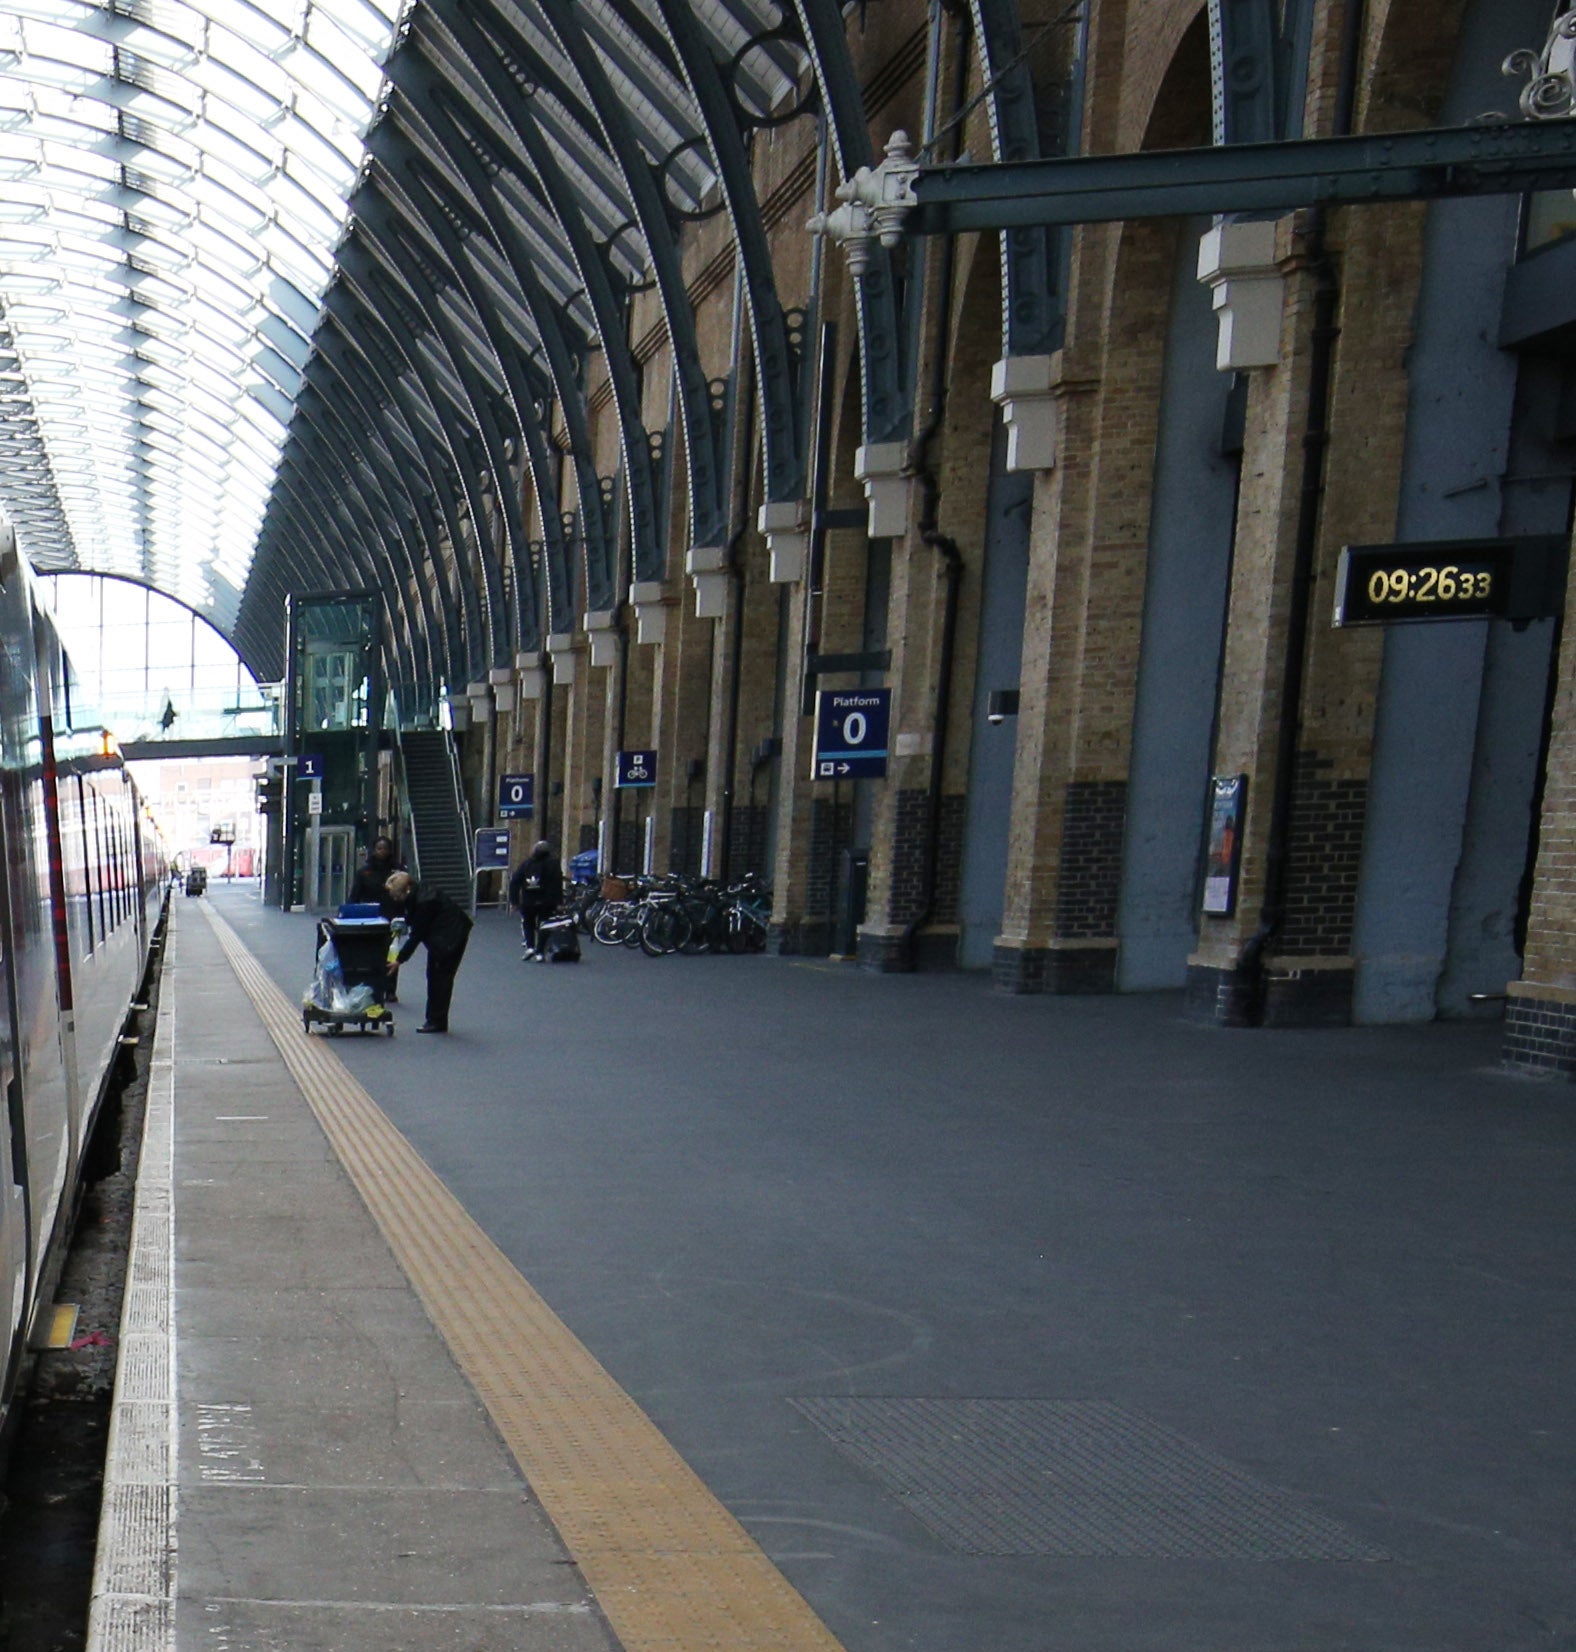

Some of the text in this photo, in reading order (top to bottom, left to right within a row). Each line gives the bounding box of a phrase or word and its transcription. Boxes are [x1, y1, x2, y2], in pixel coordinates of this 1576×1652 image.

[833, 696, 880, 707] Platform
[843, 712, 867, 745] 0
[305, 760, 314, 773] 1
[511, 785, 523, 802] 0
